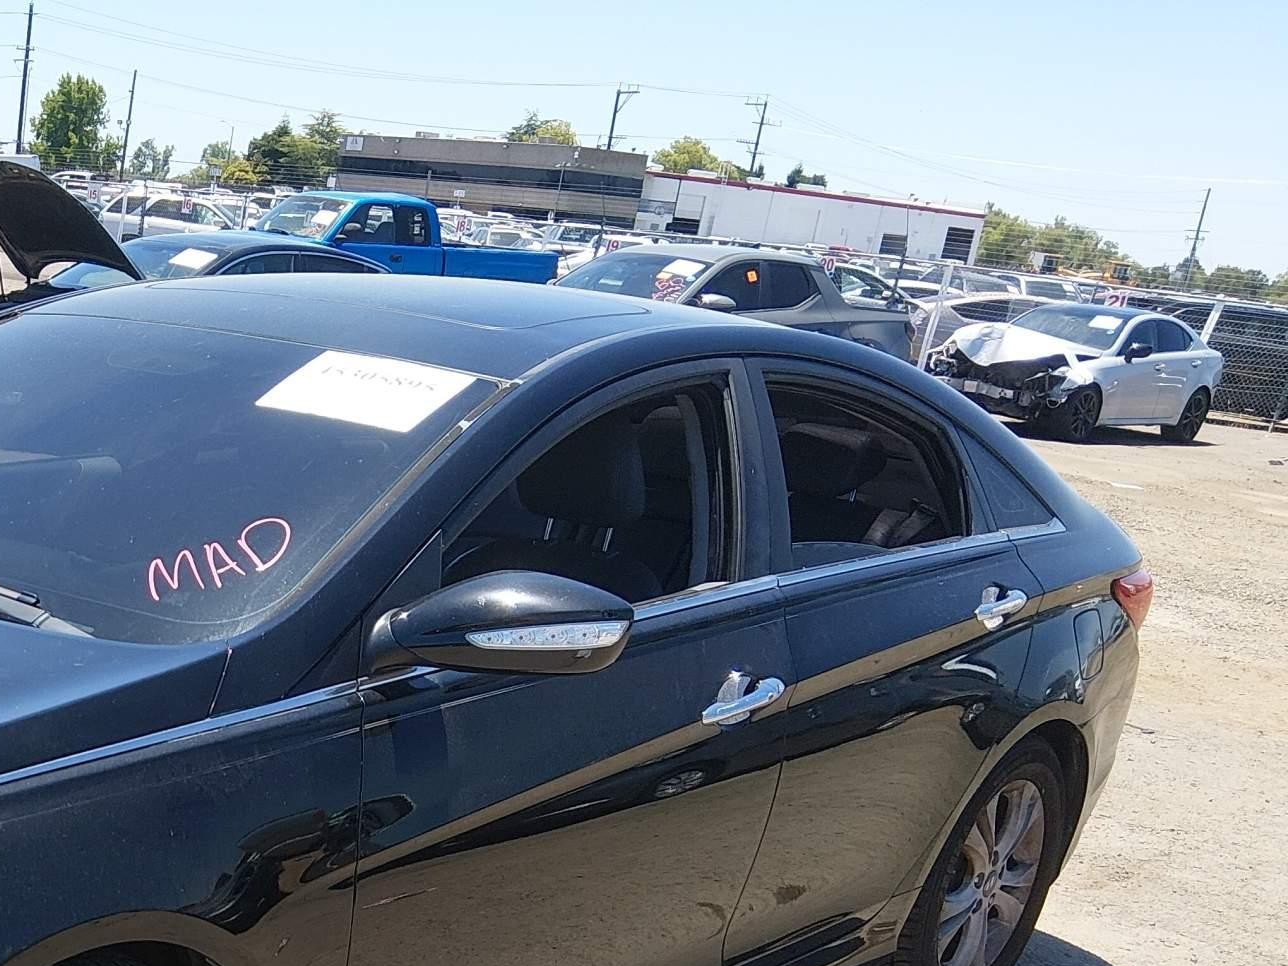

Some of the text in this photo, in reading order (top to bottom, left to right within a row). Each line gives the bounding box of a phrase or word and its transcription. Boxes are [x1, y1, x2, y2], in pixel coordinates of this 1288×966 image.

[88, 189, 97, 200] 15
[182, 197, 192, 210] 16
[455, 220, 466, 233] 18
[606, 239, 619, 252] 19
[1108, 294, 1127, 307] 21
[148, 517, 292, 601] MAD
